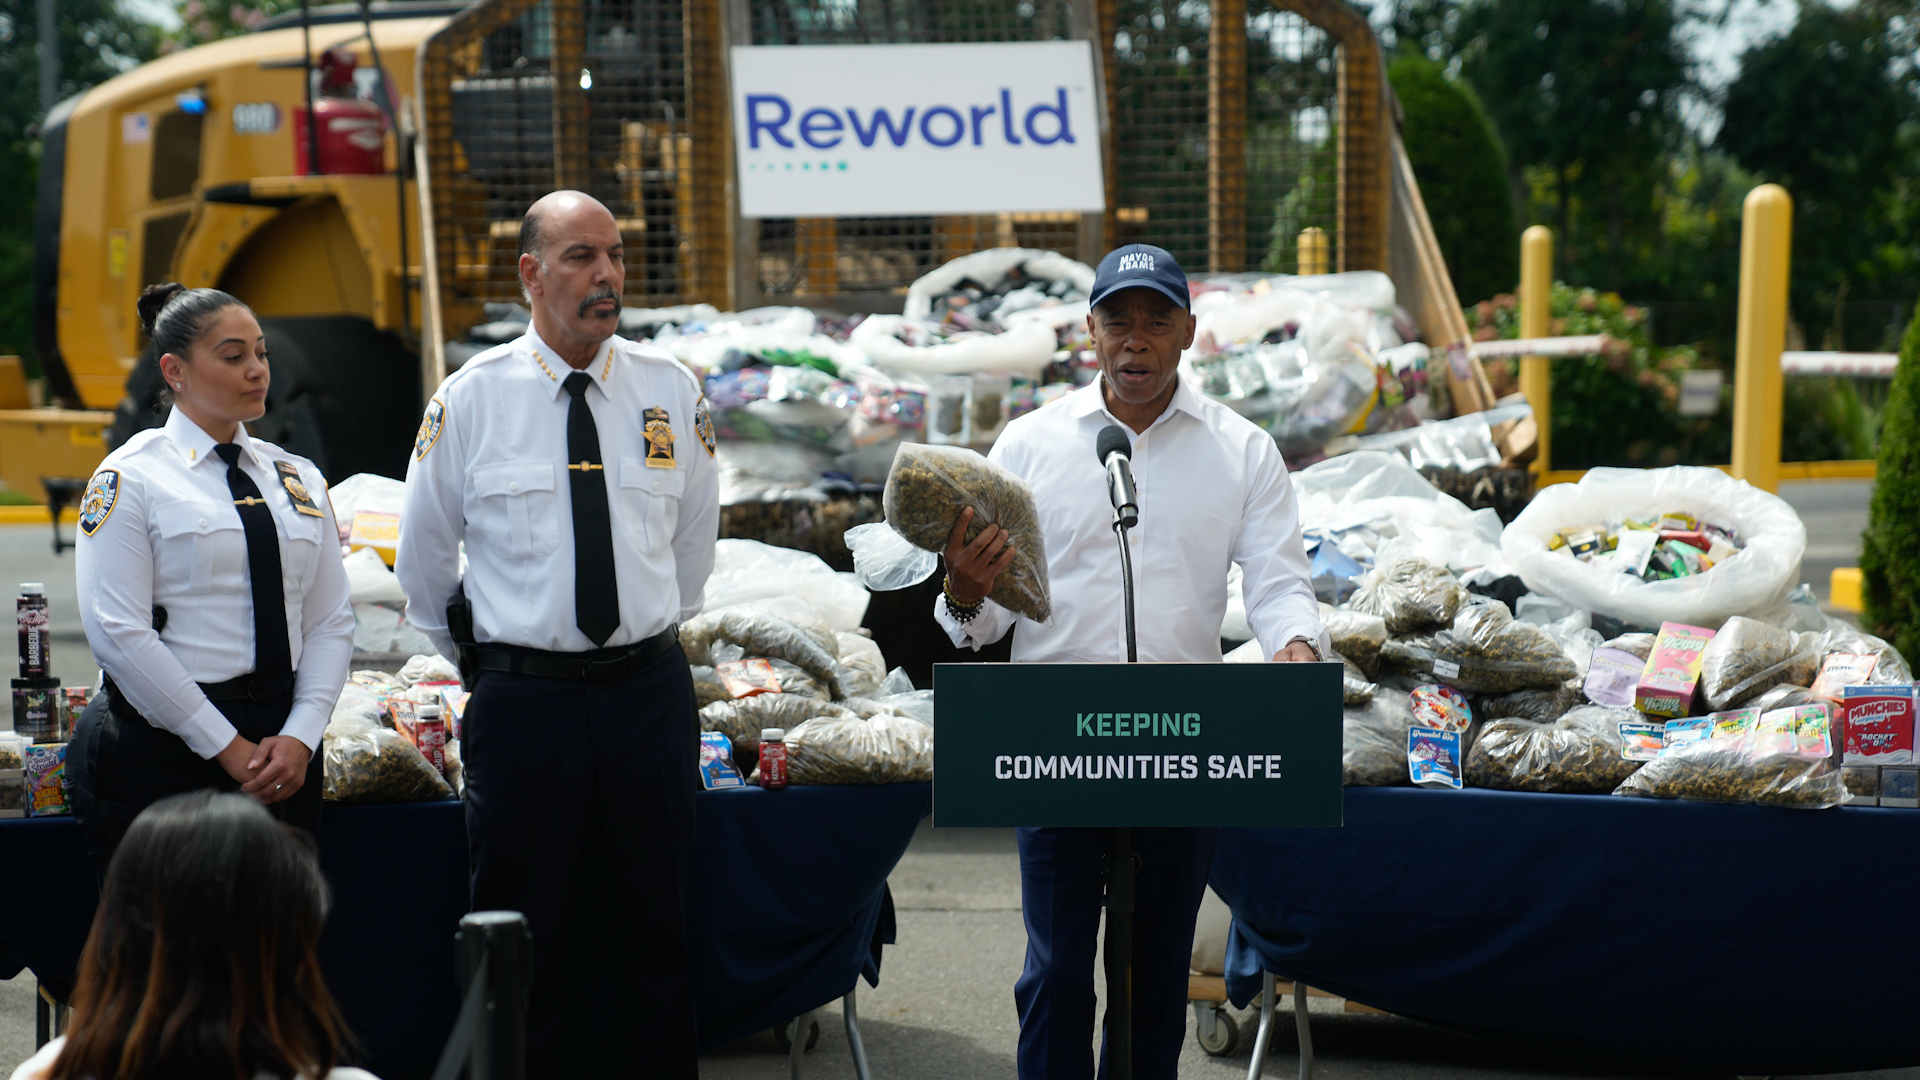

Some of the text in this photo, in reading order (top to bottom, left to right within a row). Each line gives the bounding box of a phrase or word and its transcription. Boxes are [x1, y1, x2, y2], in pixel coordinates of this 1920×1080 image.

[745, 86, 1075, 149] Reworld
[1118, 260, 1154, 272] ADAMS
[1120, 253, 1154, 265] MAYOR
[95, 489, 116, 524] NEW YORK
[28, 625, 40, 666] BARBEQUE
[1851, 701, 1905, 719] MUNCHIES
[1077, 713, 1200, 736] KEEPING
[1412, 729, 1441, 739] Presented
[1860, 733, 1895, 741] ROCKET
[434, 750, 444, 775] CHUP
[995, 755, 1281, 779] COMMUNITIES SAFE
